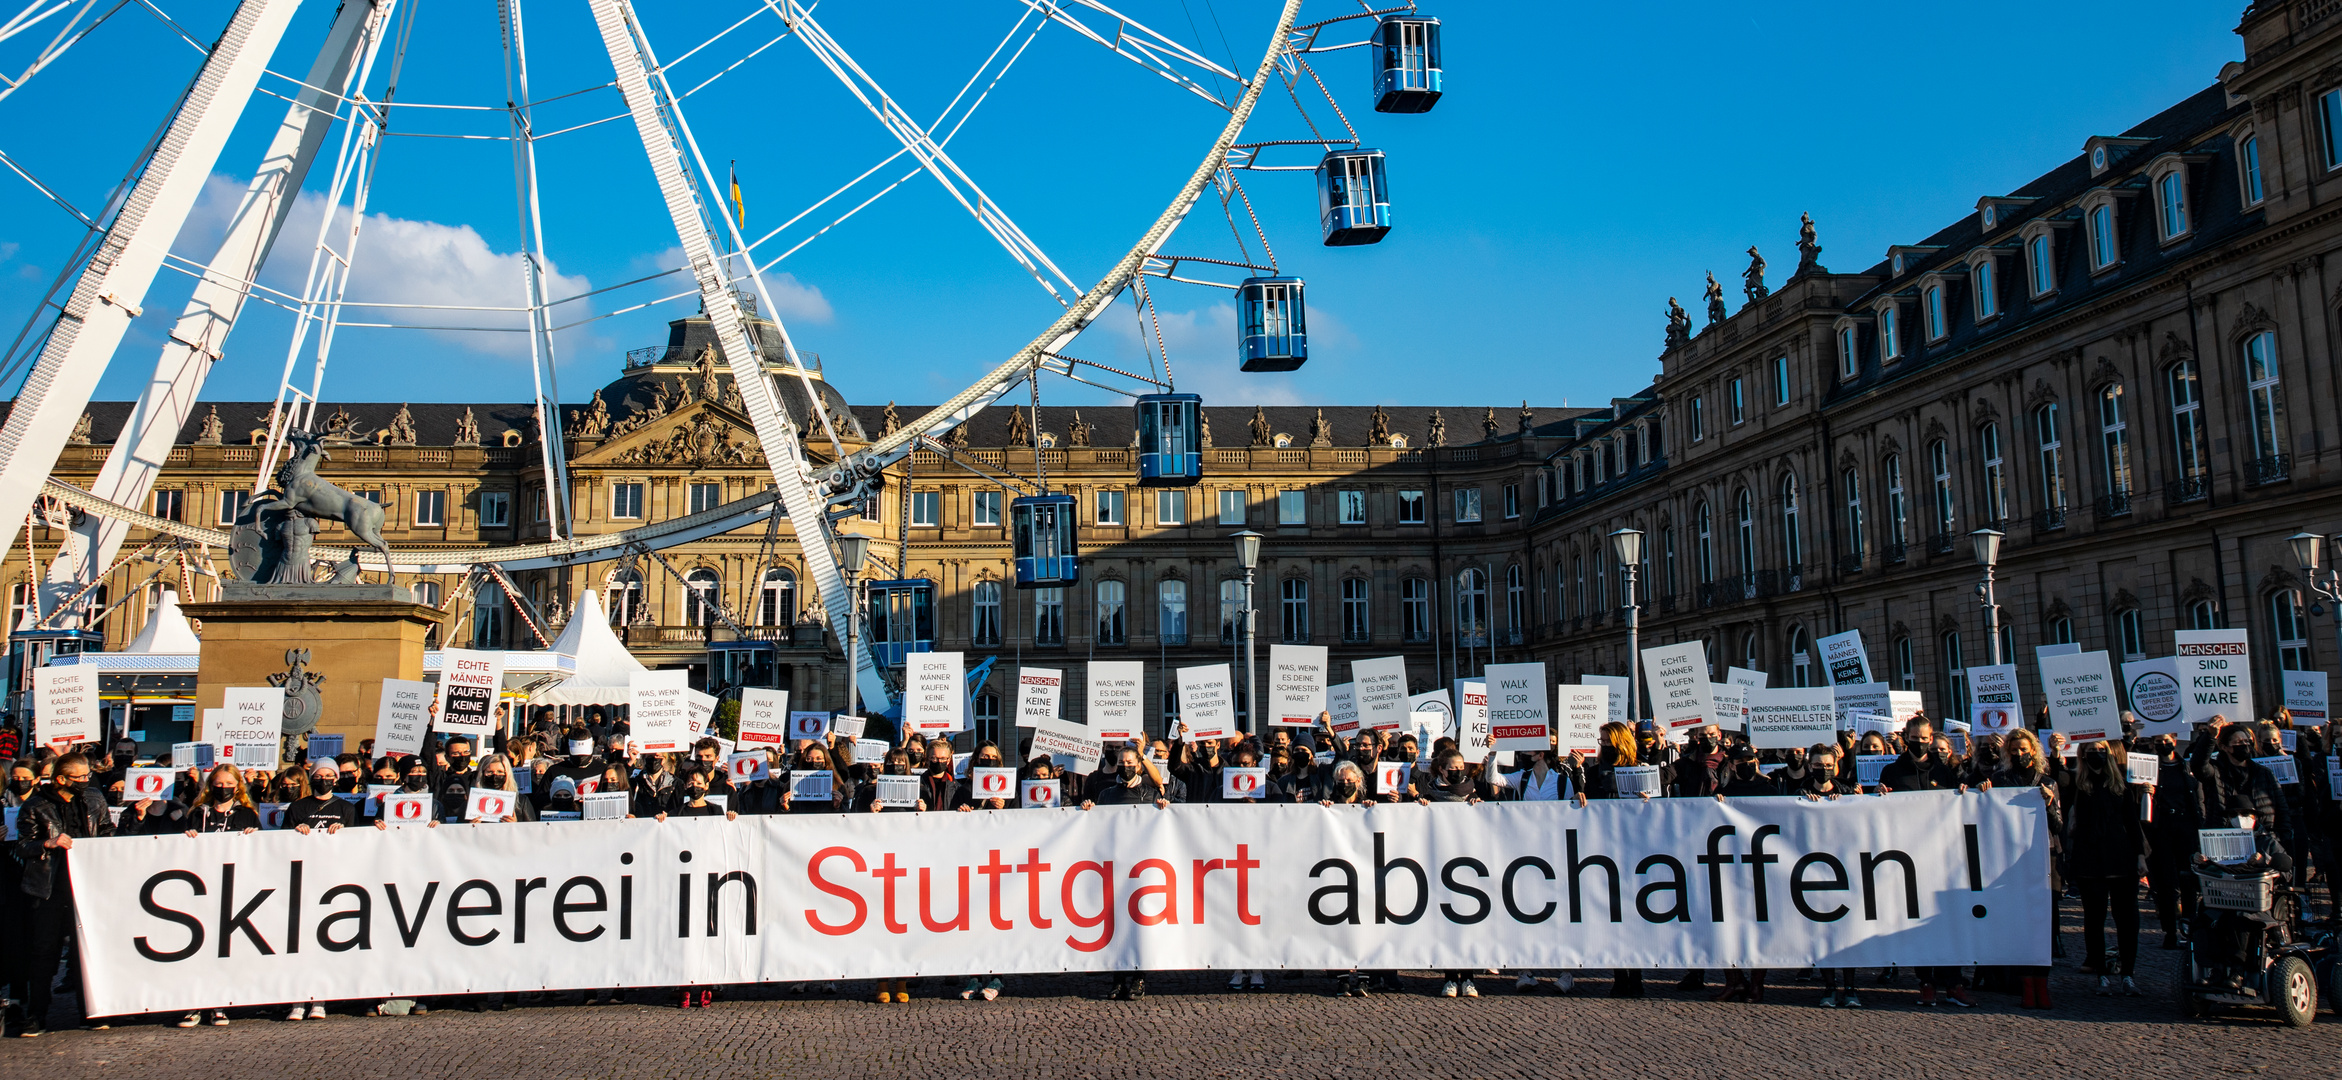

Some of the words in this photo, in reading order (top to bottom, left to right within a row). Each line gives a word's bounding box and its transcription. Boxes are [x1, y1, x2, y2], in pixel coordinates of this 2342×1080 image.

[1829, 640, 1851, 651] ECHTE
[2179, 644, 2245, 656] MENSCHEN
[1828, 648, 1858, 661] MÄNNER
[1661, 655, 1687, 666] ECHTE
[1832, 659, 1860, 670] KAUFEN
[2199, 660, 2228, 669] SIND
[458, 660, 490, 671] ECHTE
[1660, 665, 1693, 677] MÄNNER
[1837, 668, 1859, 678] KEINE
[53, 676, 79, 684] ECHTE
[450, 672, 493, 685] MÄNNER
[1021, 676, 1059, 685] MENSCHEN
[1979, 673, 2004, 682] ECHTE
[2053, 676, 2076, 685] WAS,
[2077, 673, 2102, 682] WENN
[2193, 676, 2237, 687] KEINE
[1501, 680, 1528, 689] WALK
[1663, 677, 1694, 688] KAUFEN
[2149, 683, 2173, 691] SEKUNDEN
[49, 685, 84, 695] MÄNNER
[449, 686, 490, 698] KAUFEN
[1977, 683, 2010, 693] MÄNNER
[2074, 685, 2099, 694] DEINE
[2136, 683, 2148, 693] 30
[397, 691, 418, 700] ECHTE
[1286, 694, 1309, 702] WÄRE?
[1334, 693, 1350, 701] WALK
[1362, 693, 1402, 702] SCHWESTER
[1670, 689, 1691, 698] KEINE
[51, 696, 82, 705] KAUFEN
[1026, 698, 1051, 706] KEINE
[1507, 695, 1527, 704] FOR
[1979, 694, 2012, 703] KAUFEN
[2056, 695, 2108, 708] SCHWESTER
[2142, 697, 2158, 705] OPFER
[2194, 693, 2238, 704] WARE
[239, 703, 265, 711] WALK
[392, 700, 420, 710] MÄNNER
[453, 701, 483, 711] KEINE
[1186, 700, 1226, 709] SCHWESTER
[1372, 702, 1394, 710] WÄRE?
[1666, 699, 1699, 710] FRAUEN.
[1751, 705, 1805, 713] MENSCHENHANDEL
[2143, 703, 2175, 711] MENSCHEN-
[392, 712, 417, 721] KAUFEN
[1025, 708, 1050, 716] WARE
[1492, 709, 1542, 719] FREEDOM
[2069, 707, 2098, 717] WÄRE?
[2147, 708, 2174, 716] HANDELS
[51, 718, 85, 726] FRAUEN.
[242, 717, 263, 725] FOR
[445, 713, 486, 724] FRAUEN
[1752, 715, 1764, 723] AM
[1768, 713, 1831, 723] SCHNELLSTEN
[394, 723, 412, 731] KEINE
[647, 719, 671, 727] WÄRE?
[742, 721, 780, 730] FREEDOM
[1791, 723, 1832, 731] KRIMINALITÄT
[224, 731, 274, 739] FREEDOM
[1496, 728, 1541, 736] STUTTGART
[388, 733, 415, 742] FRAUEN.
[1038, 729, 1083, 744] MENSCHENHANDEL
[1092, 740, 1100, 748] DIE
[1035, 736, 1046, 744] AM
[1048, 739, 1099, 756] SCHNELLSTEN
[133, 851, 633, 963] Sklaverei
[678, 850, 758, 938] in
[804, 843, 1262, 952] Stuttgart
[1307, 824, 1920, 926] abschaffen
[1964, 823, 1987, 919] !
